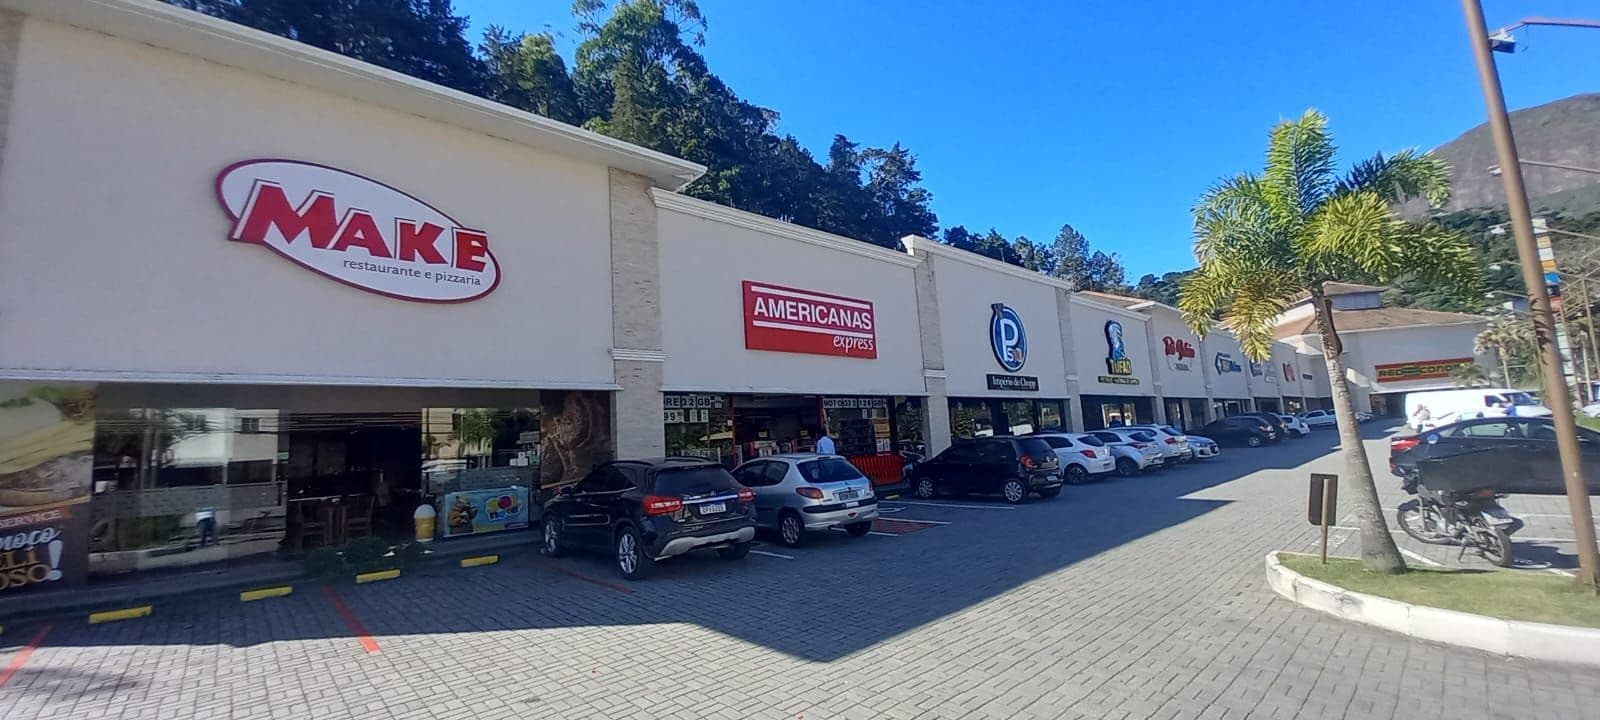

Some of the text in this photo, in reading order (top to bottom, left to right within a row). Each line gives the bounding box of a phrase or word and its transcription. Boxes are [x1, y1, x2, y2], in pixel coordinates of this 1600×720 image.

[231, 180, 488, 272] MAKE
[343, 259, 481, 286] restaurante e pizzaria
[753, 297, 872, 330] AMERICANAS
[833, 336, 873, 353] express
